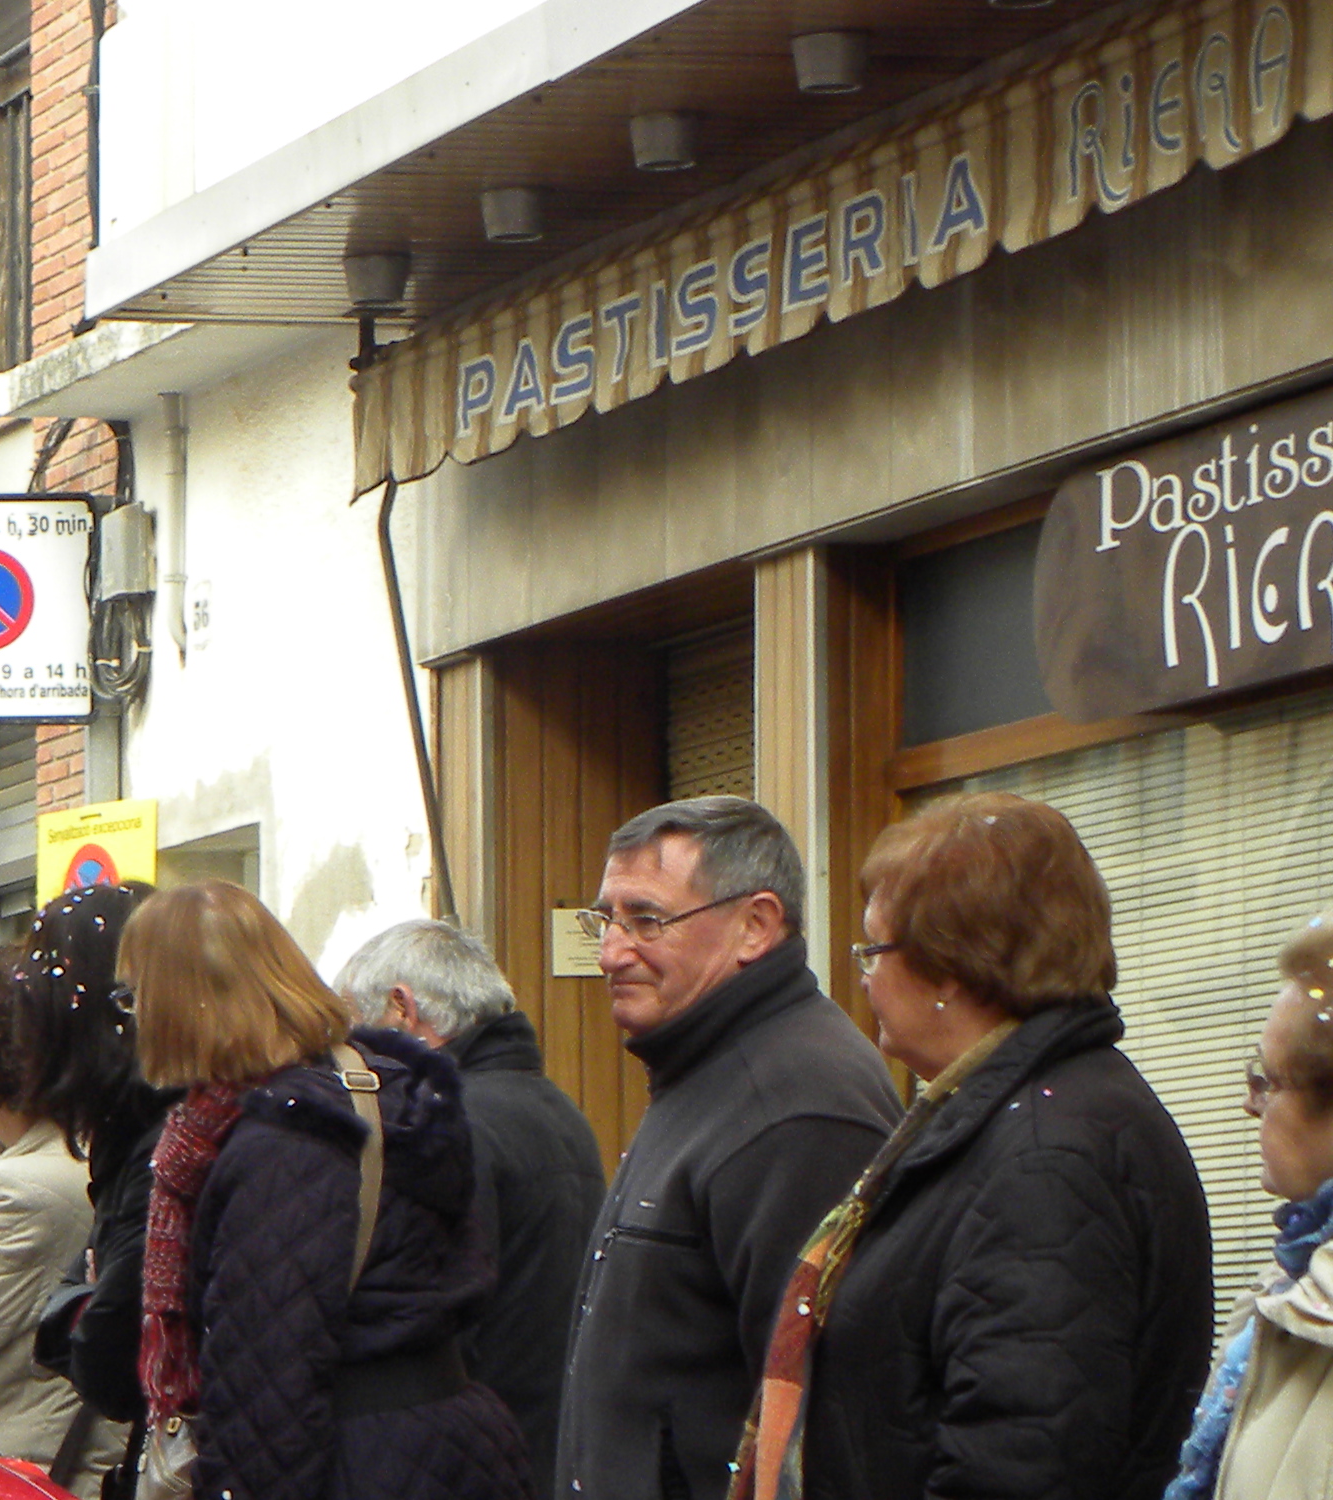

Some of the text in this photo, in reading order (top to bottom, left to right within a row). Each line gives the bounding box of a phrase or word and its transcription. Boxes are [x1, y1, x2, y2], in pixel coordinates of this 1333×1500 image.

[455, 152, 989, 437] PASTISSERIA
[27, 513, 50, 536] 30
[1, 664, 12, 680] 9
[23, 666, 34, 679] a
[46, 663, 64, 679] 14
[29, 683, 89, 699] d'arribada
